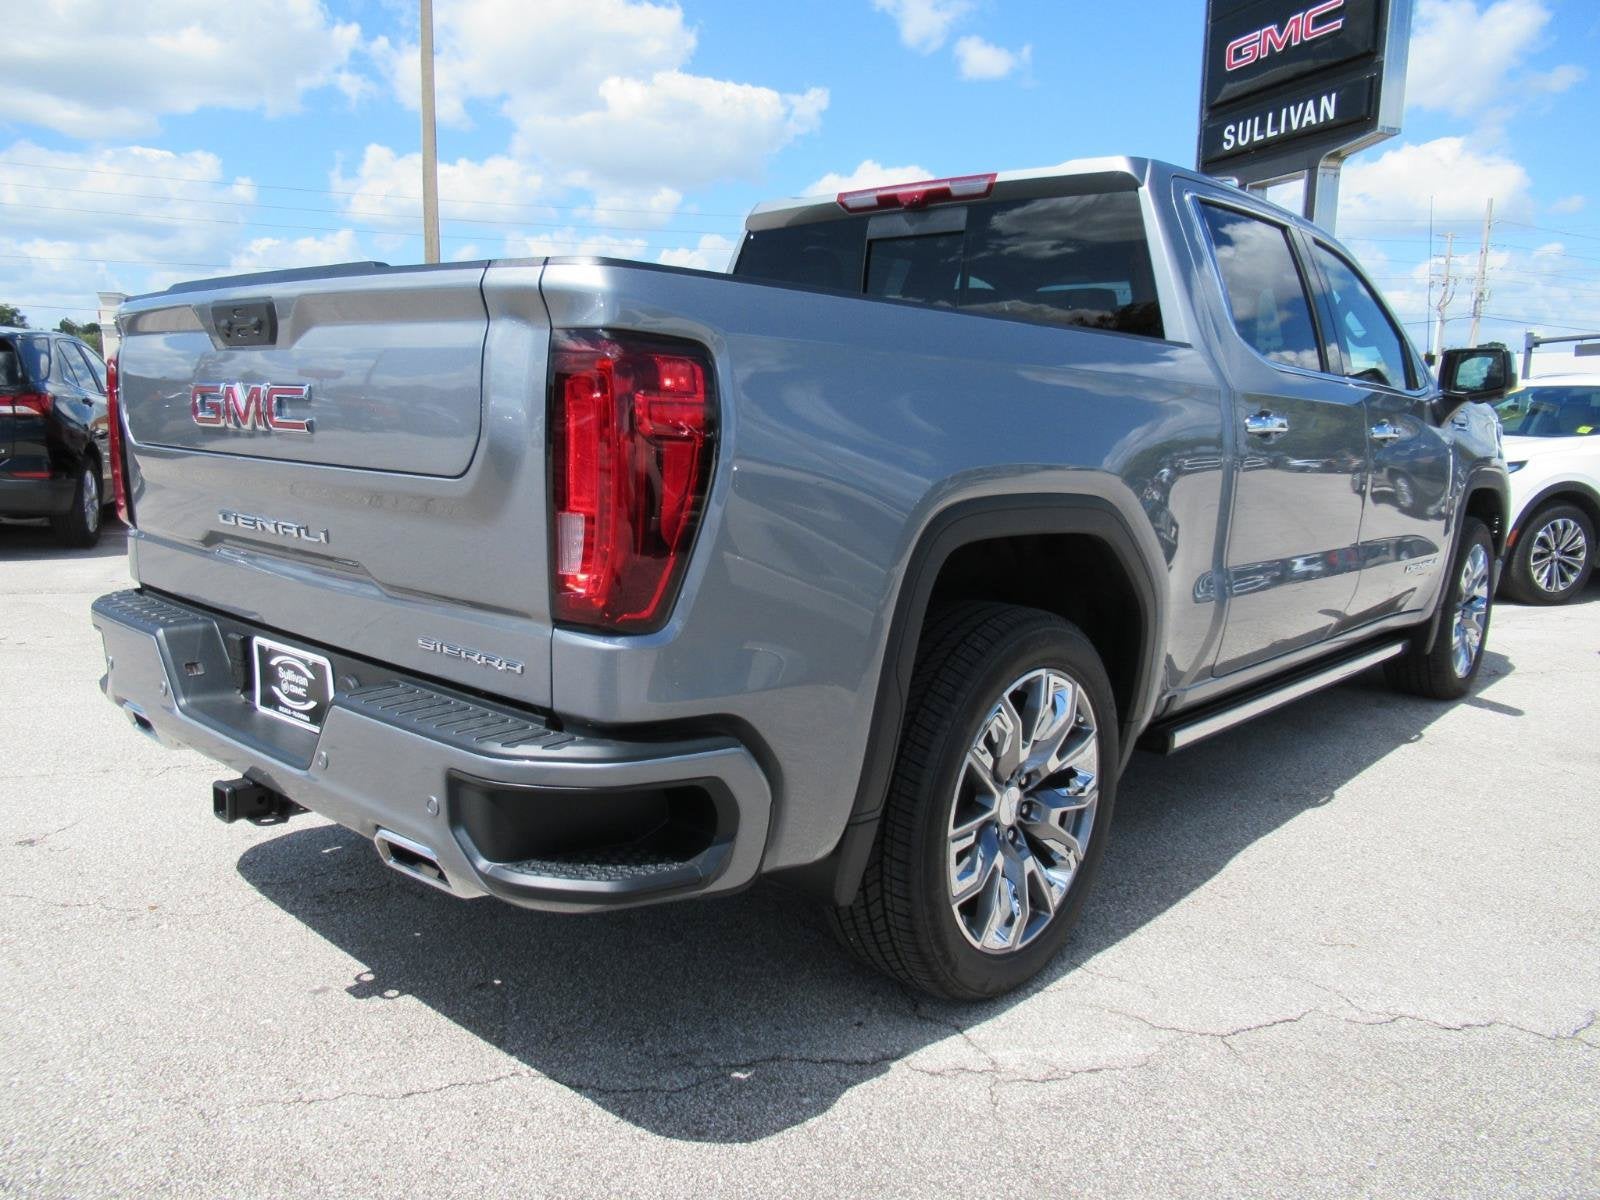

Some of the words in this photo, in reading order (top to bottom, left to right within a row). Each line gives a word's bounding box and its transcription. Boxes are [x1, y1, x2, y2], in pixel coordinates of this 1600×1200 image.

[1225, 0, 1344, 71] GMC
[1222, 92, 1337, 150] SULLIVAN
[191, 382, 314, 434] GMC
[218, 509, 330, 544] DENALI
[278, 666, 309, 688] Sullivan
[417, 637, 525, 675] SIERRA
